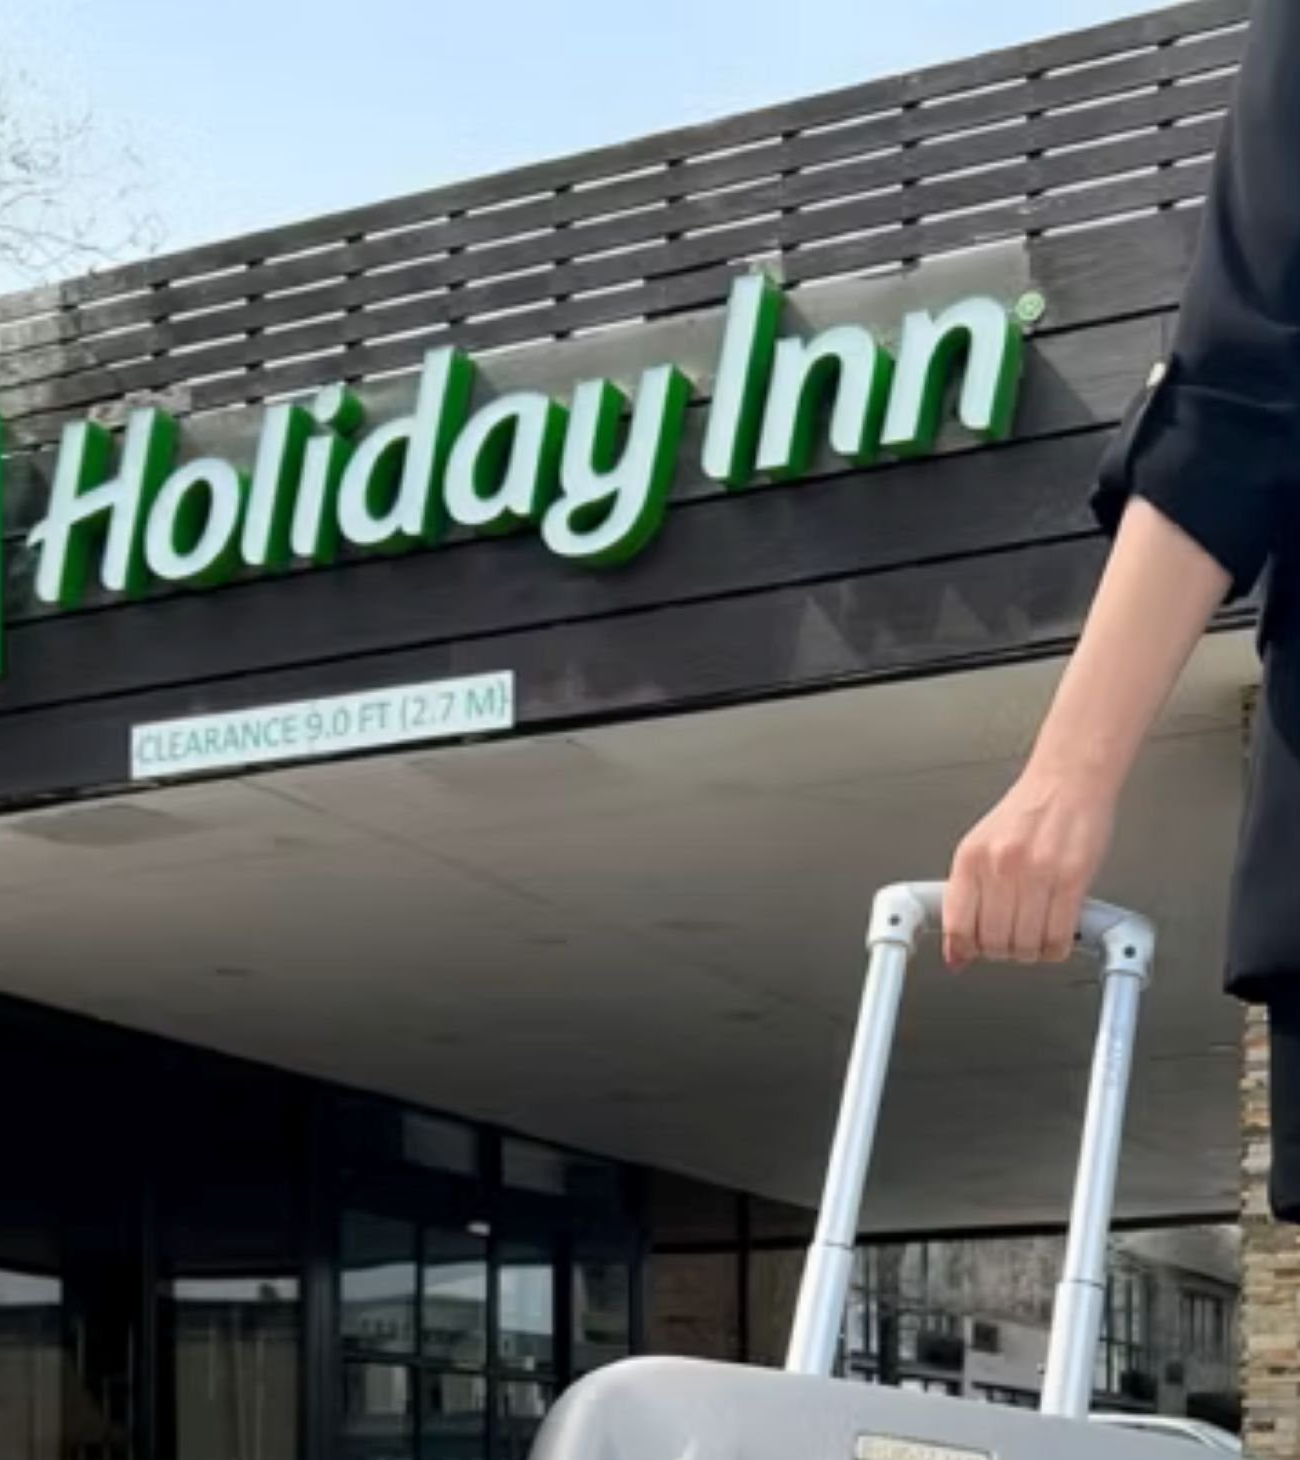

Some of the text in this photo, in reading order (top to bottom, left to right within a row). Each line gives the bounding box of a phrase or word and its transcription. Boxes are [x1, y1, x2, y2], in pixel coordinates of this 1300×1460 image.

[26, 274, 1009, 602] Holiday Inn
[139, 680, 508, 765] CLEARANCE 9.0 FT (2.7 M)
